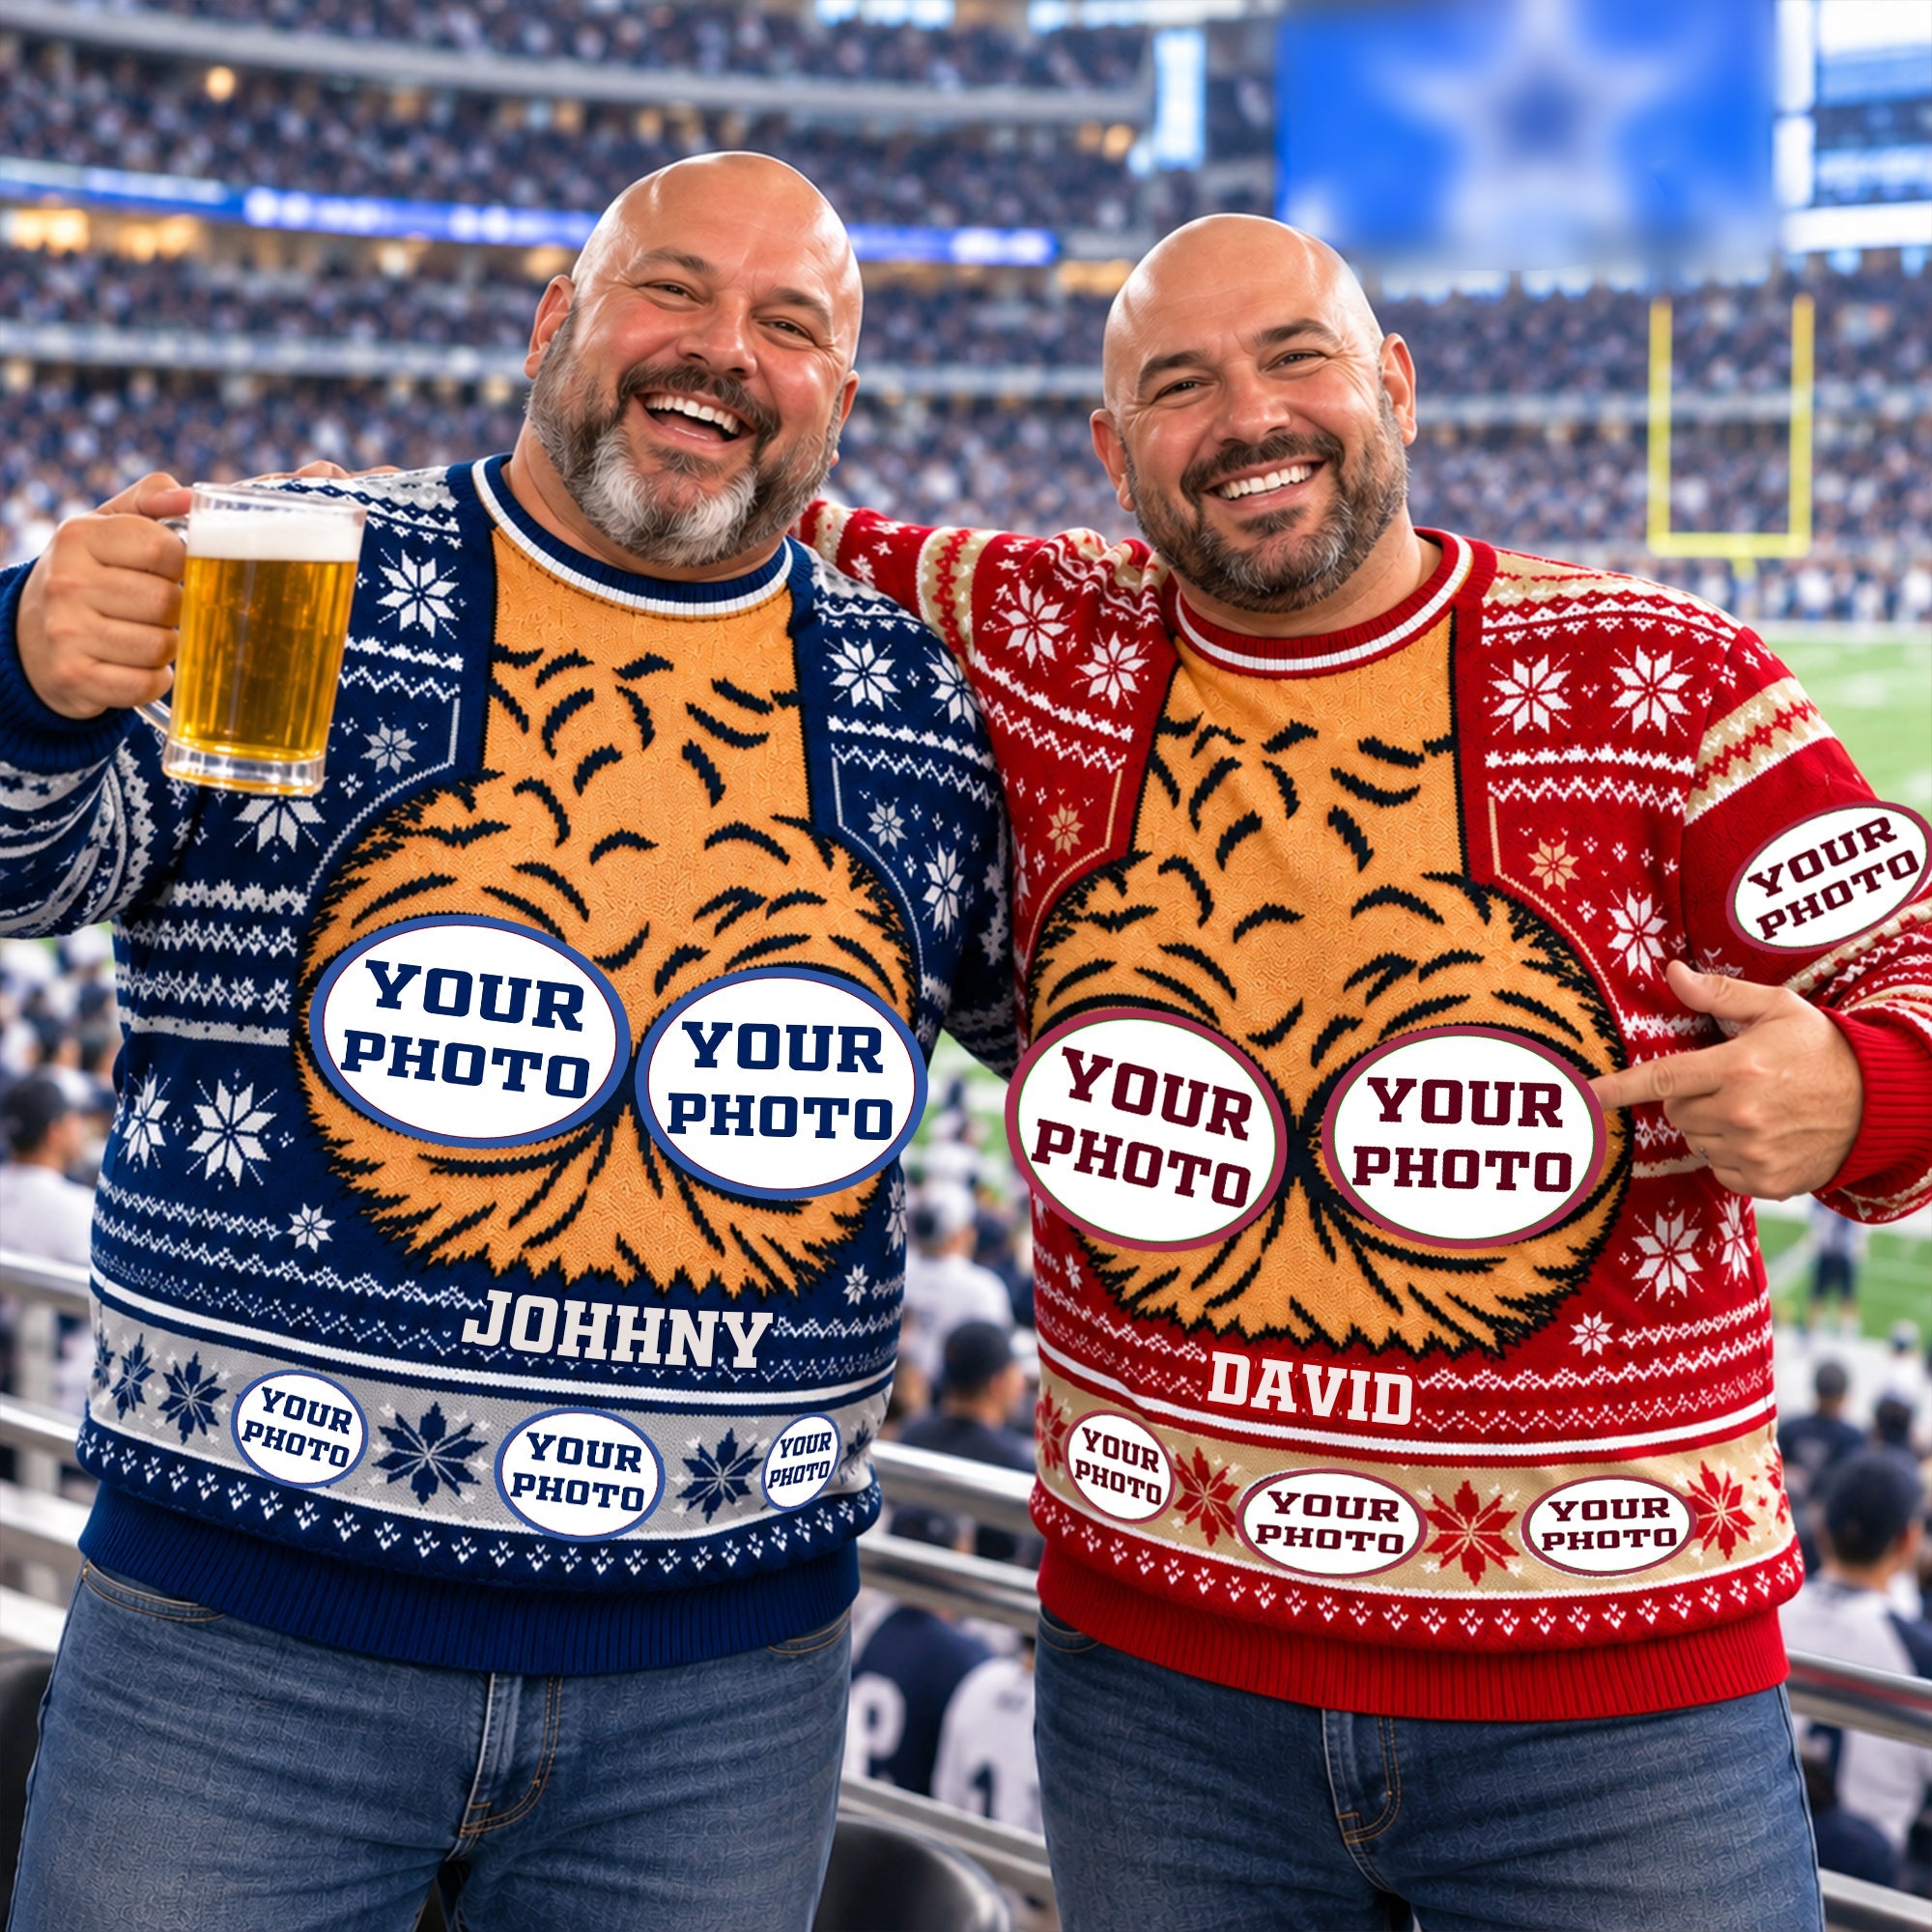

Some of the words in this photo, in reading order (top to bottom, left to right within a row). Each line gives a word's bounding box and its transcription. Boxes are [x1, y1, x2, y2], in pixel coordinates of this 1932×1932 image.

[1747, 817, 1897, 897] YOUR
[1756, 850, 1919, 940] PHOTO
[365, 959, 583, 1032] YOUR
[341, 1030, 589, 1099] PHOTO
[682, 1021, 883, 1073] YOUR
[668, 1093, 893, 1140] PHOTO
[1062, 1047, 1252, 1141] YOUR
[1368, 1077, 1563, 1127] YOUR
[1031, 1119, 1251, 1208] PHOTO
[1352, 1146, 1572, 1192] PHOTO
[462, 1290, 773, 1369] JOHHNY
[262, 1386, 352, 1435] YOUR
[1208, 1351, 1412, 1425] DAVID
[242, 1420, 349, 1467] PHOTO
[526, 1432, 641, 1473] YOUR
[781, 1432, 832, 1458] YOUR
[1082, 1427, 1158, 1473] YOUR
[511, 1472, 644, 1511] PHOTO
[768, 1461, 830, 1489] PHOTO
[1076, 1460, 1161, 1505] PHOTO
[1267, 1492, 1399, 1522] YOUR
[1548, 1498, 1669, 1521] YOUR
[1256, 1524, 1404, 1554] PHOTO
[1542, 1528, 1676, 1550] PHOTO
